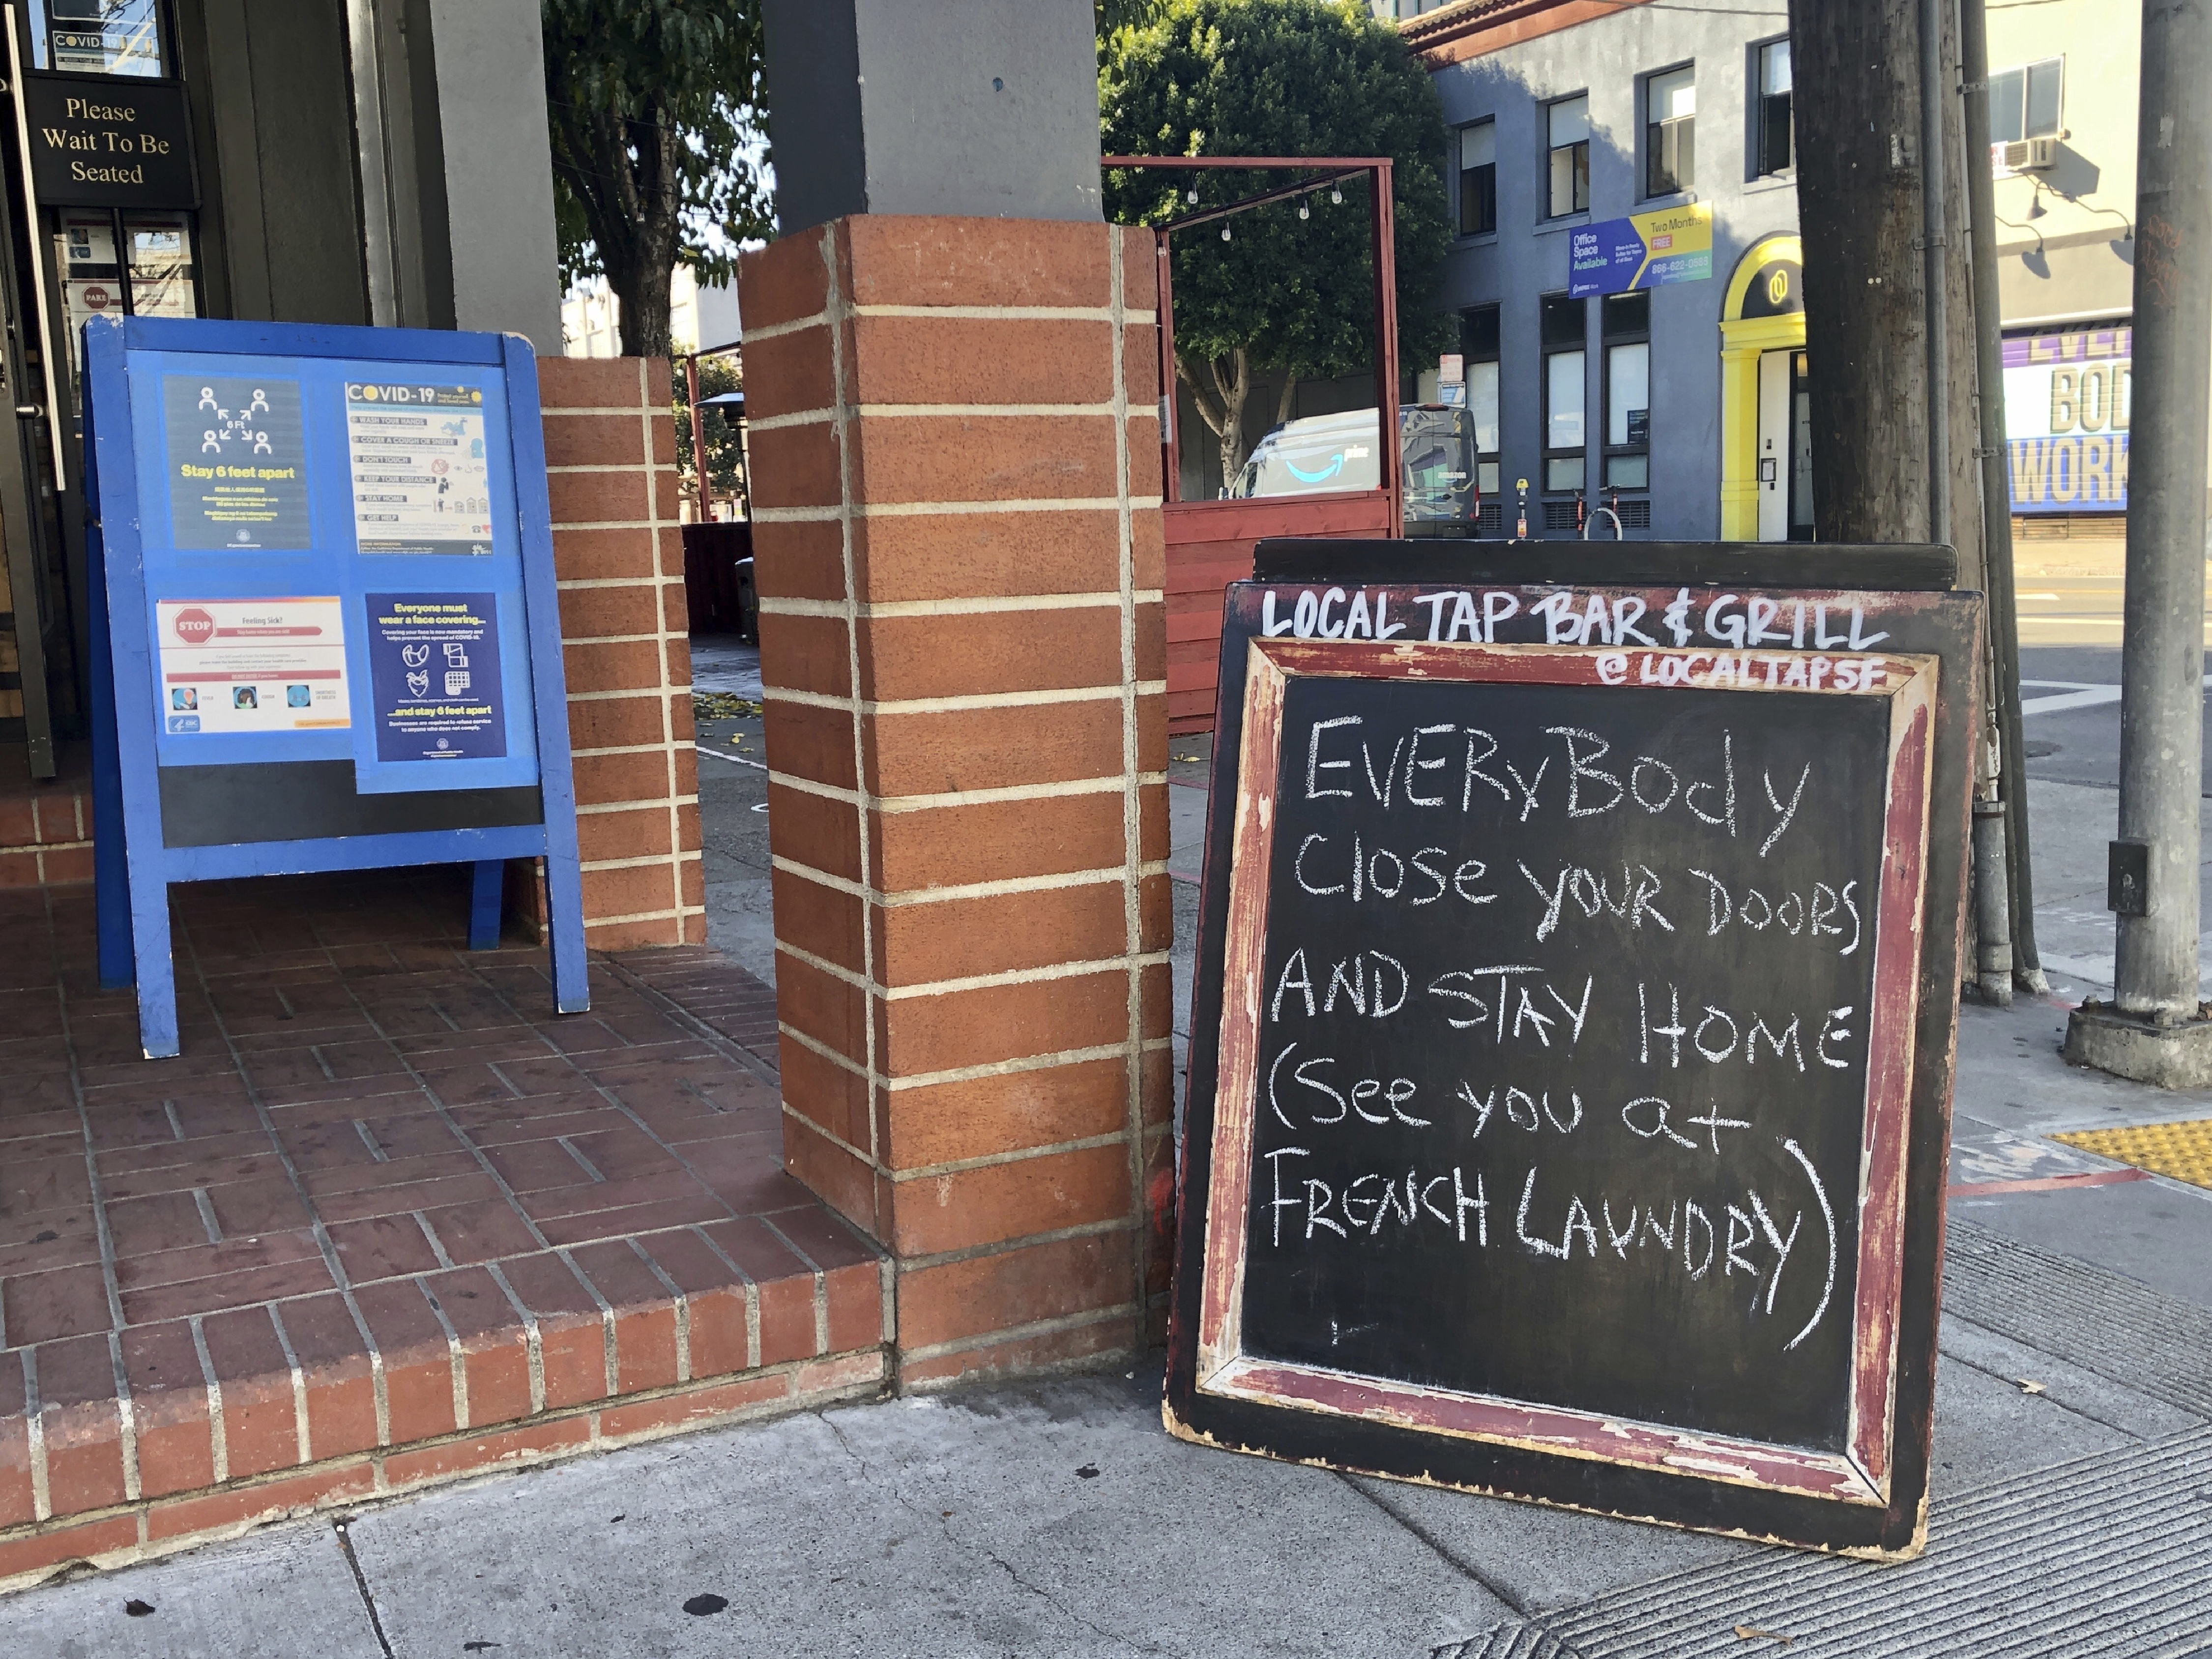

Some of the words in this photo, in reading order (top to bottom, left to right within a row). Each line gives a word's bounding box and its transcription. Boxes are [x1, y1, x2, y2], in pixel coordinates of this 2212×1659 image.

[66, 98, 136, 121] Please
[42, 128, 97, 150] Wait
[102, 132, 133, 152] To
[139, 134, 170, 154] Be
[71, 161, 144, 183] Seated
[1651, 222, 1667, 233] Two
[1669, 215, 1703, 230] Months
[1574, 233, 1597, 246] Office
[1652, 236, 1671, 249] FREE
[1573, 245, 1599, 260] Space
[1573, 256, 1608, 270] Available
[348, 384, 435, 403] COVID-19
[1344, 444, 1369, 462] prime
[181, 464, 214, 479] Stay
[216, 466, 226, 477] 6
[228, 466, 256, 478] feet
[258, 467, 295, 480] apart
[394, 604, 441, 614] Everyone
[443, 604, 467, 612] must
[179, 621, 211, 631] STOP
[412, 615, 435, 624] face
[1261, 587, 1406, 639] LOCAL
[1412, 591, 1519, 643] TAP
[1530, 591, 1659, 646] BAR
[1662, 587, 1696, 648] &
[1705, 594, 1890, 650] GRILL
[414, 707, 436, 717] stay
[437, 706, 444, 715] 6
[445, 705, 465, 715] feet
[466, 705, 492, 716] apart
[1688, 867, 1862, 955] DOORS
[1270, 948, 1409, 1022] AND
[1427, 964, 1593, 1048] STAY
[1638, 982, 1853, 1072] HOME
[1621, 1098, 1753, 1155] at
[1260, 1146, 1488, 1248] FRENCH
